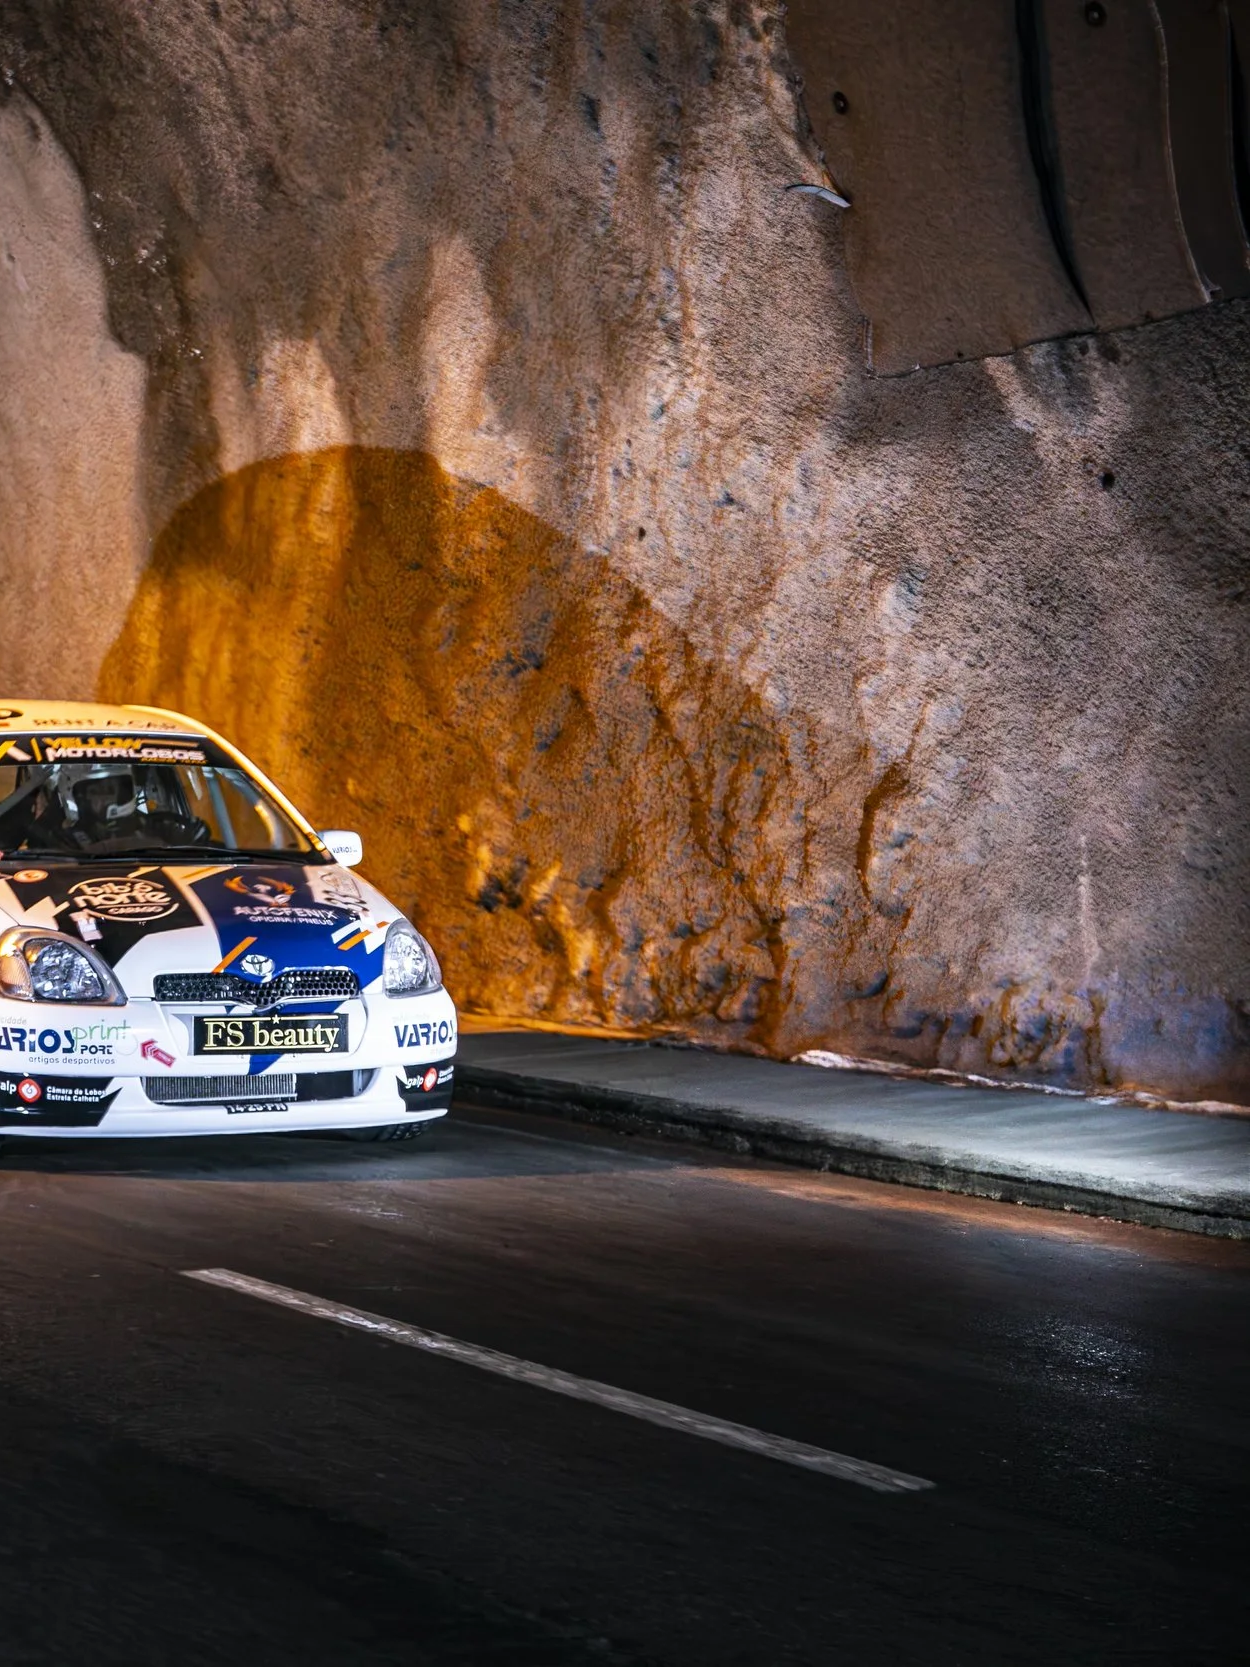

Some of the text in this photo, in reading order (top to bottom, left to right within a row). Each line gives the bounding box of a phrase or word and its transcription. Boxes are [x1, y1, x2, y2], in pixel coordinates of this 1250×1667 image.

[42, 736, 142, 751] YELLOW
[45, 747, 207, 762] MOTORLOBOS
[73, 891, 172, 908] norte
[233, 905, 338, 920] AUTOFENIX
[299, 917, 334, 926] PNEUS
[72, 1019, 132, 1051] print
[204, 1020, 340, 1053] FS beauty
[28, 1056, 116, 1065] artigos desportivos
[406, 1076, 424, 1089] galp
[46, 1086, 73, 1096] Câmara
[84, 1088, 106, 1097] Lobos
[46, 1093, 99, 1103] Estrela Calheta
